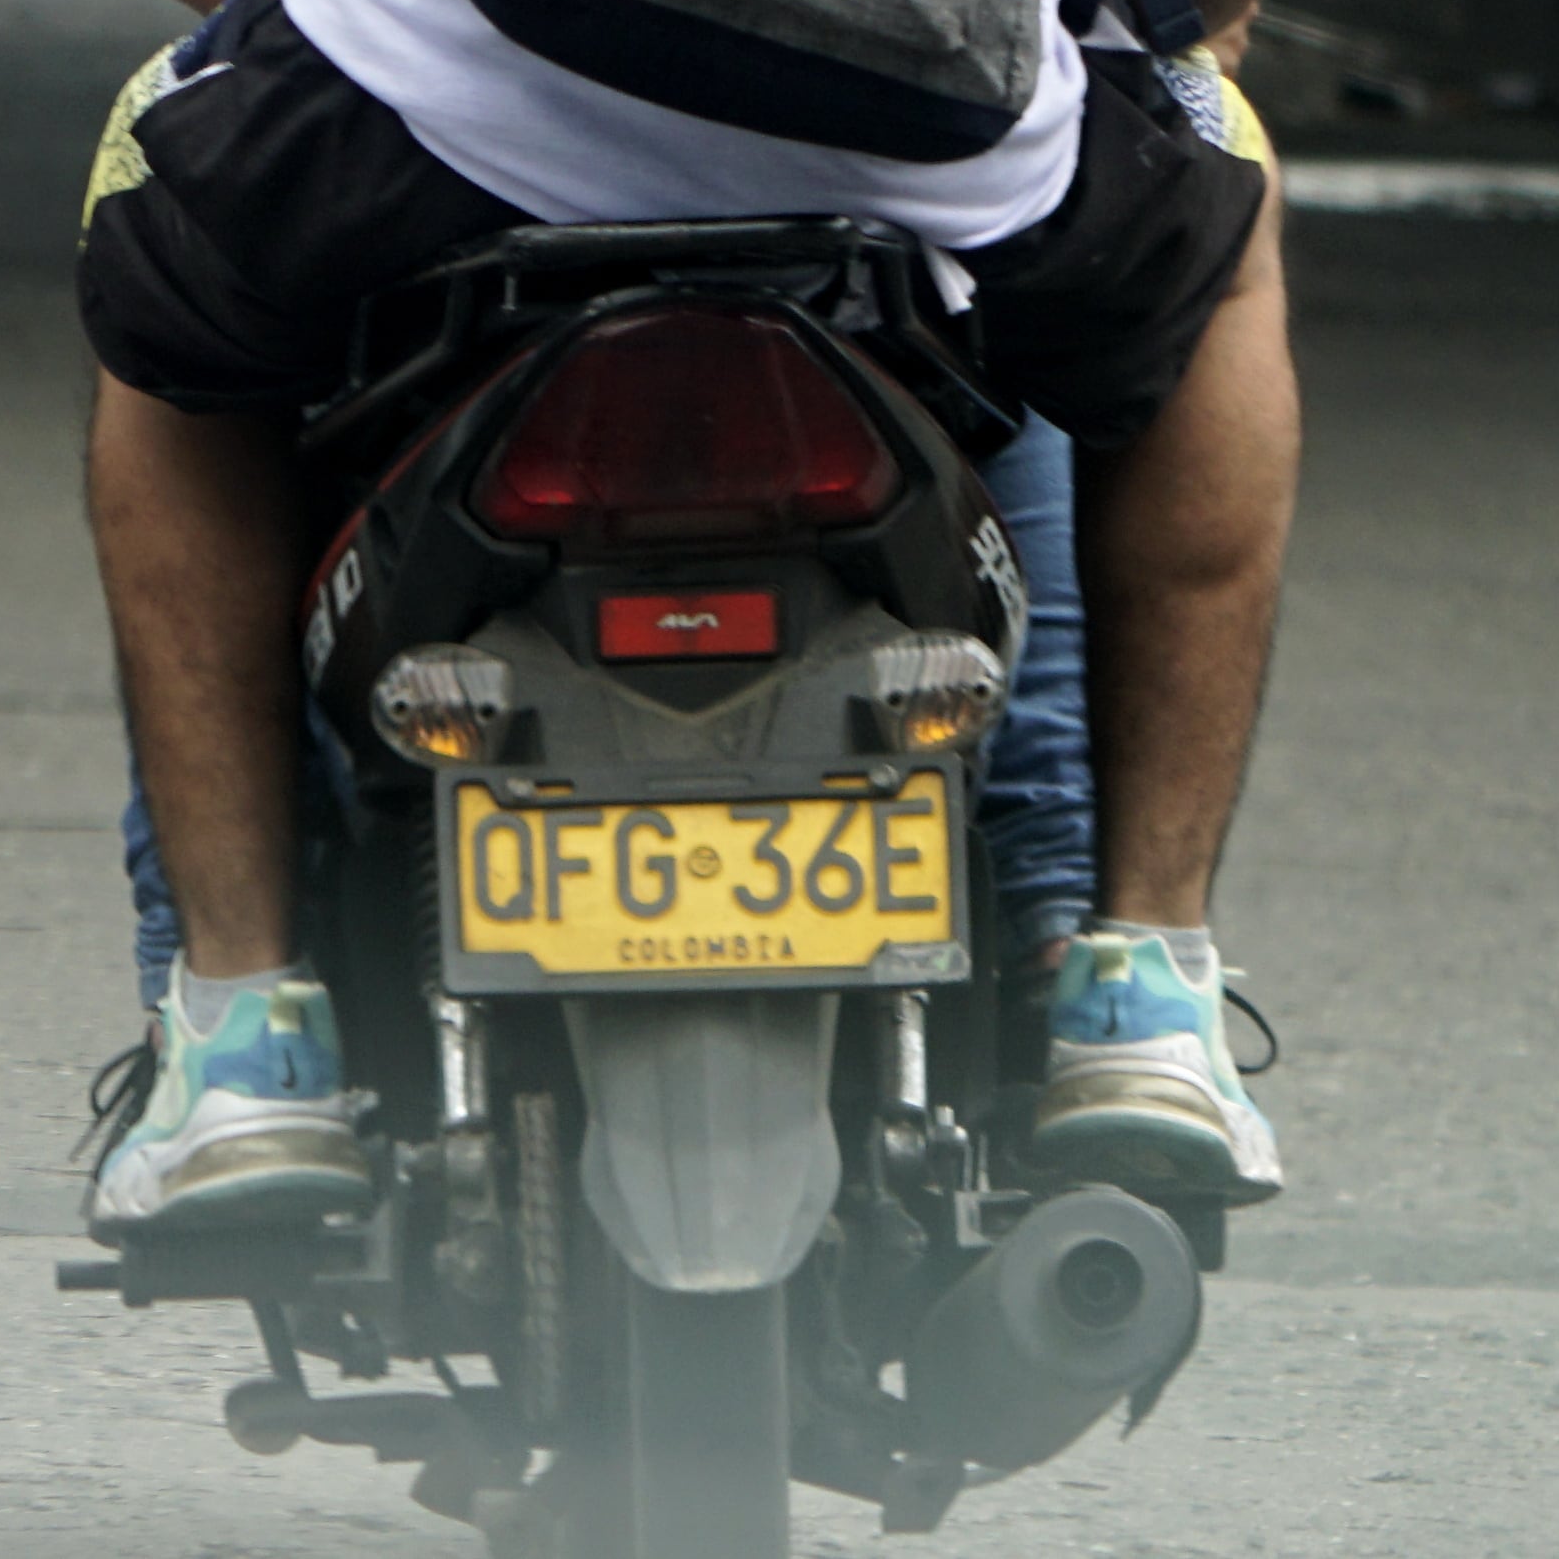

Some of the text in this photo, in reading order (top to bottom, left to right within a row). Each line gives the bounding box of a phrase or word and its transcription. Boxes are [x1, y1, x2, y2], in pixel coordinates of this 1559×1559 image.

[472, 798, 938, 922] QFG 36E
[618, 935, 795, 962] COLOMBIA
